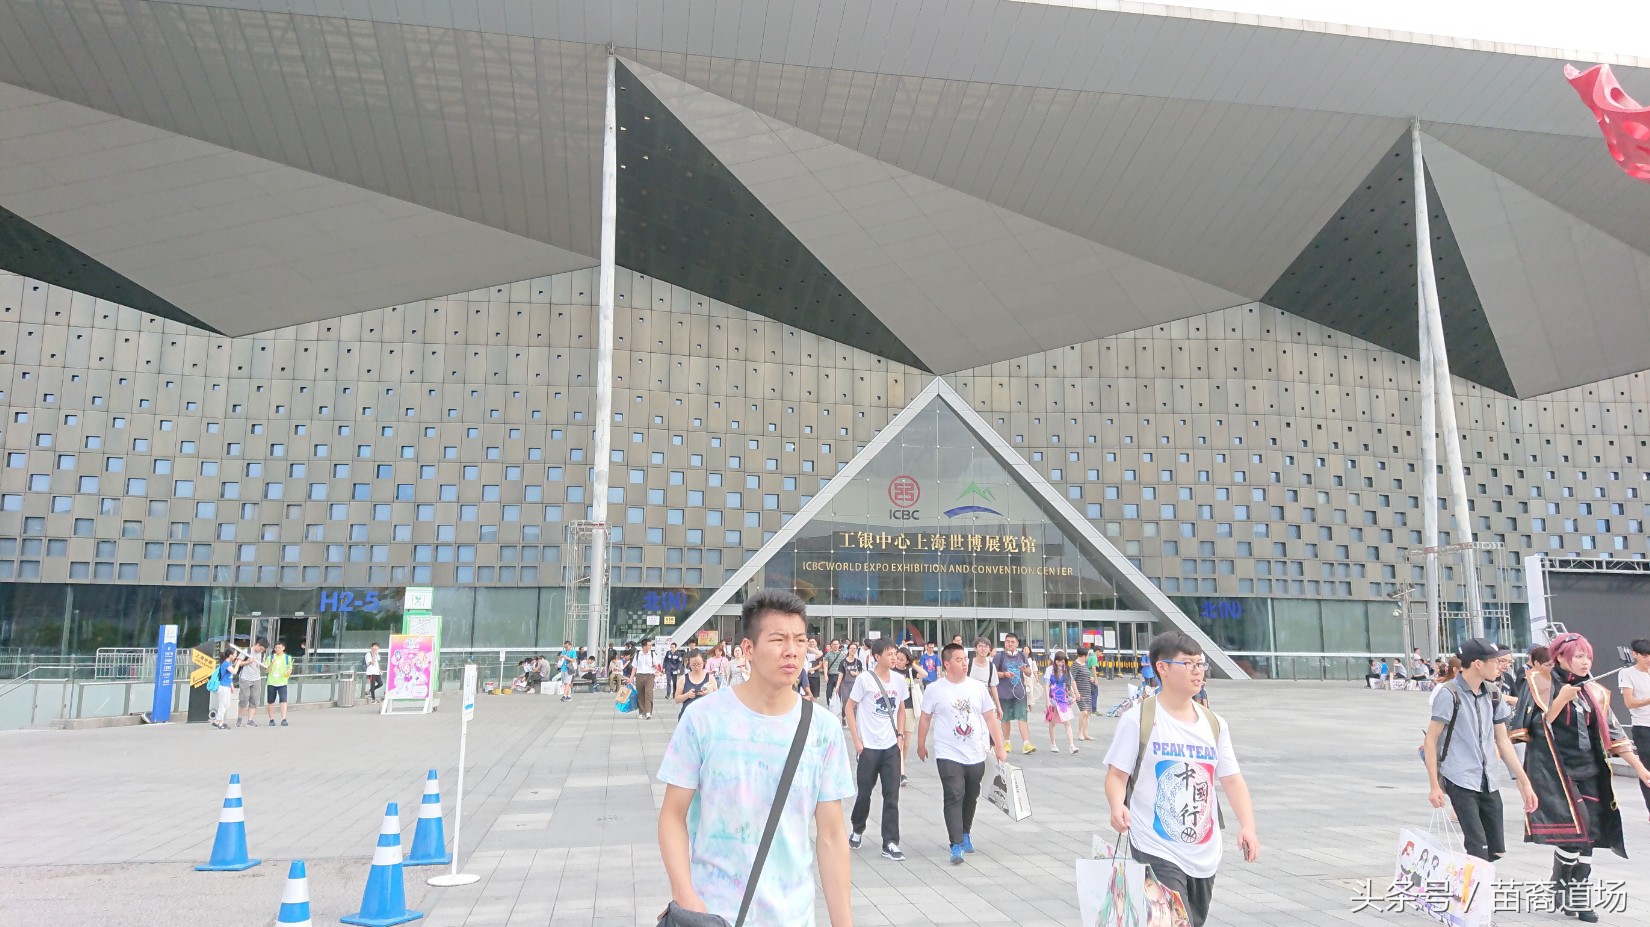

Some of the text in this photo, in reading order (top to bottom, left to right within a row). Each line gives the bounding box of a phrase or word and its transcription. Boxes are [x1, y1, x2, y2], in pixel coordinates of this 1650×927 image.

[889, 509, 920, 520] ICBC
[839, 531, 1037, 553] 工银中心上海世博展览馆
[802, 561, 1073, 576] ICBC WORLD EXPO EXHIBITION AND CONVENTION CENTER
[319, 591, 380, 612] H2-5
[1153, 742, 1186, 757] PEAK
